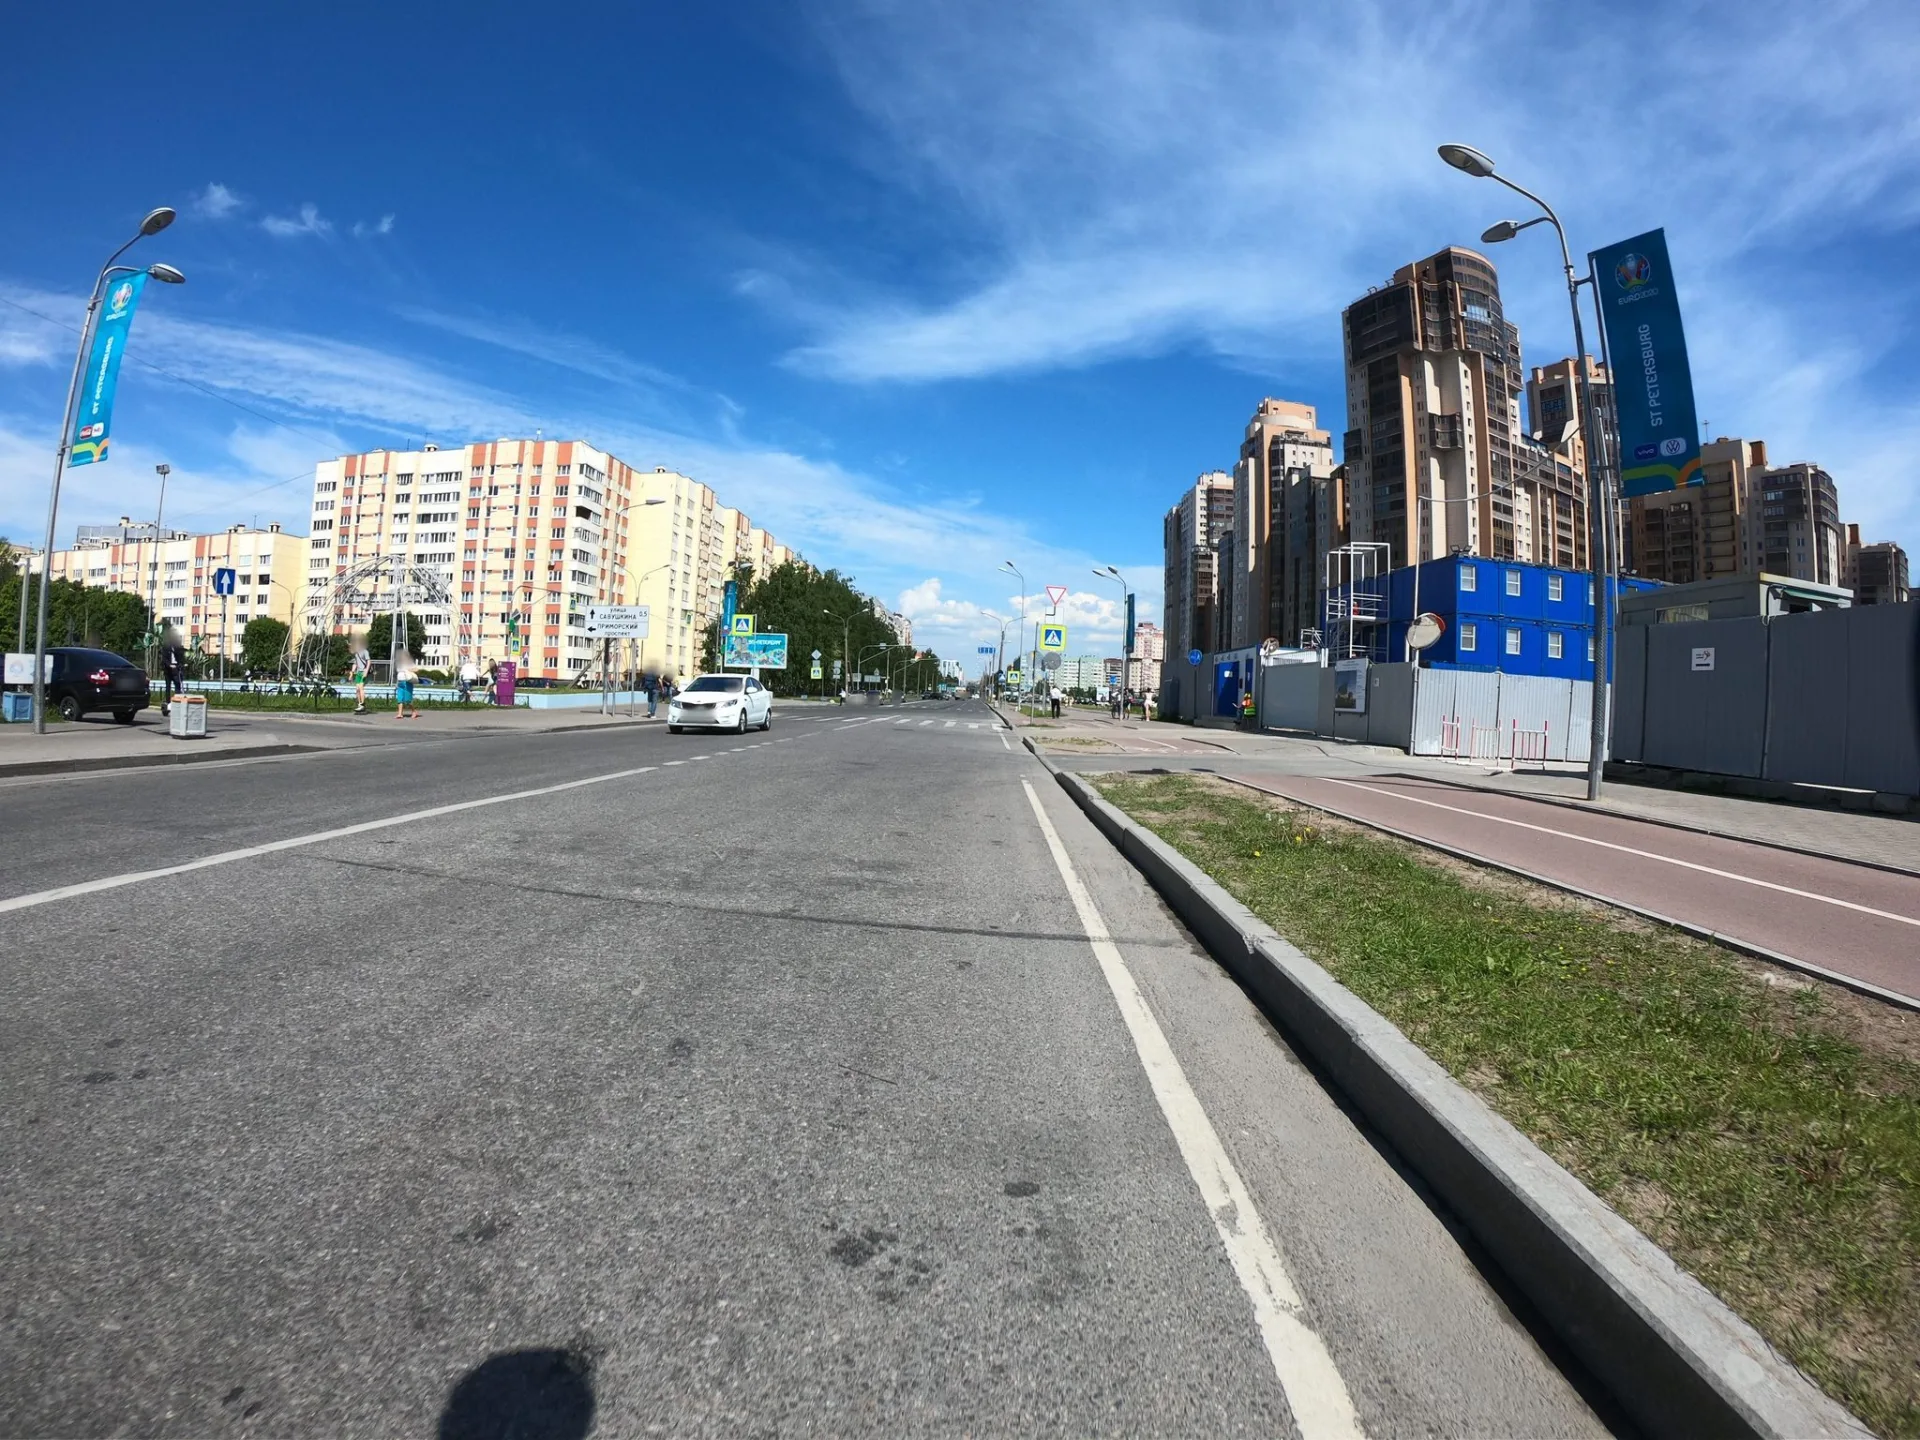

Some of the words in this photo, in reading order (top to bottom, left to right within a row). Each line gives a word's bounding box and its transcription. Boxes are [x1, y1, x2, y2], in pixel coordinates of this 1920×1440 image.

[1638, 324, 1661, 407] PETERSBURG
[1650, 411, 1663, 427] ST
[597, 622, 638, 630] ПРИМОРСКИЙ
